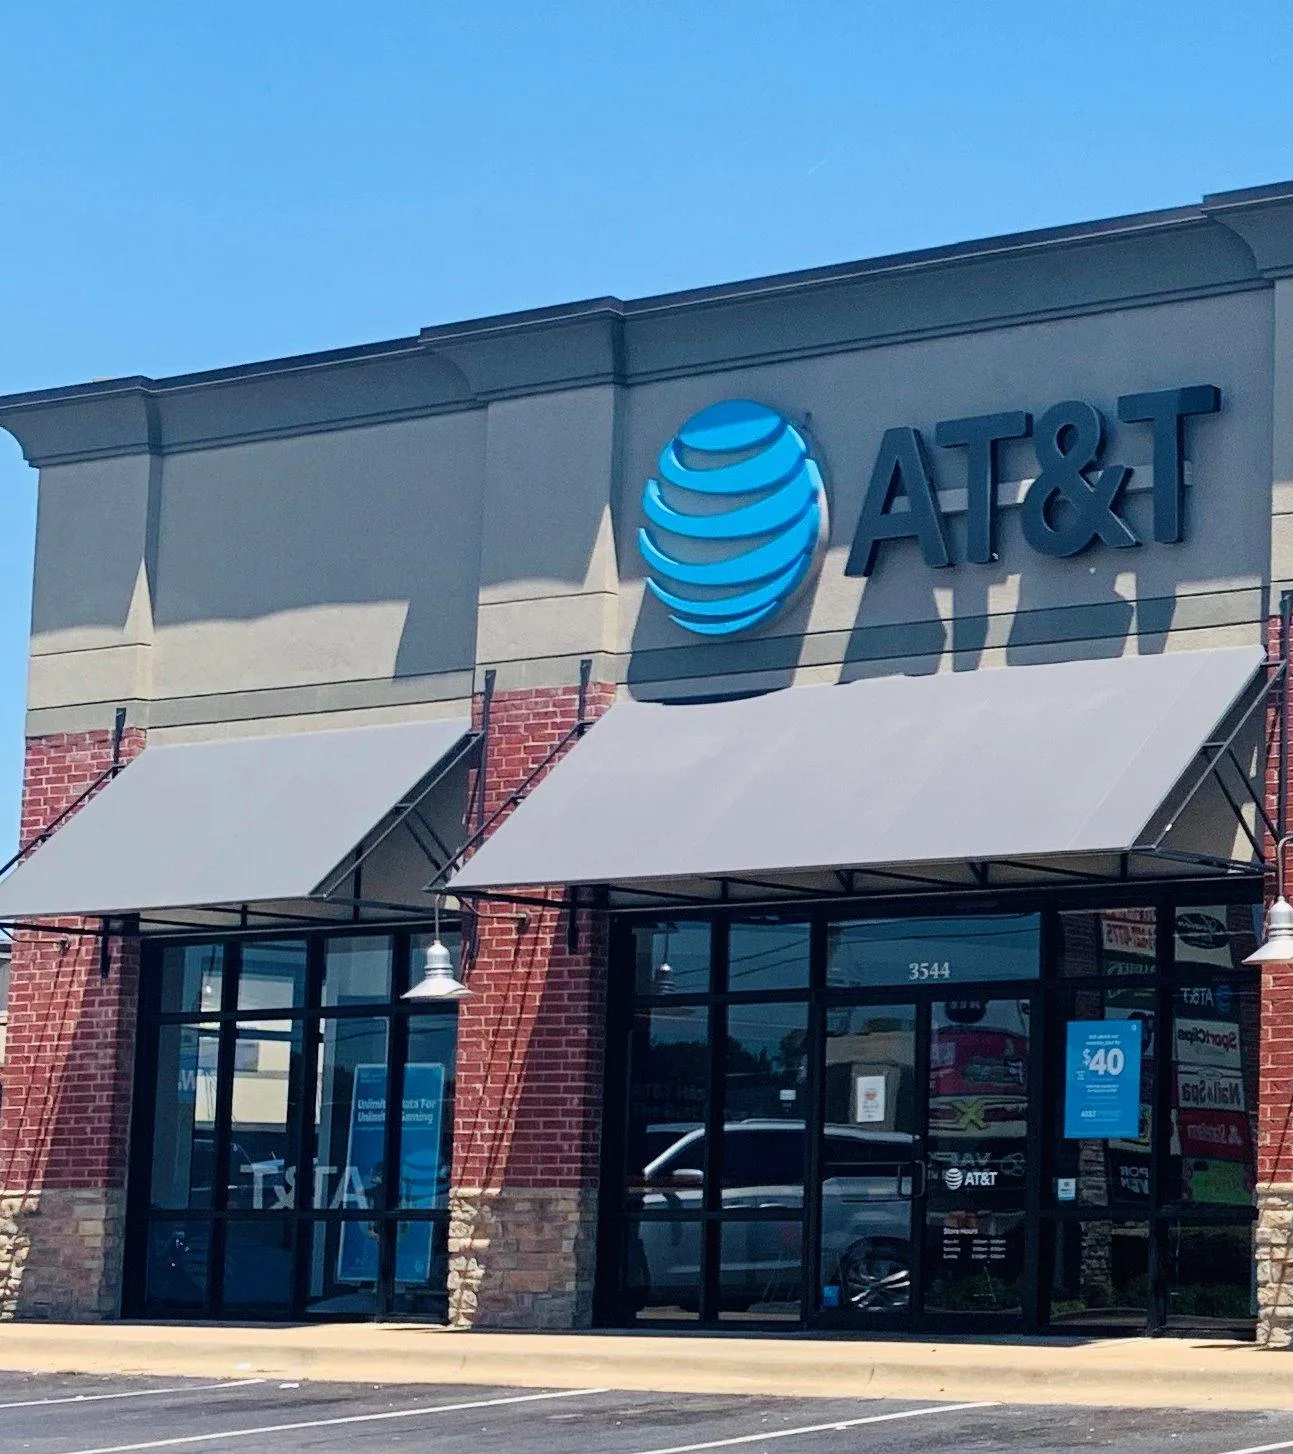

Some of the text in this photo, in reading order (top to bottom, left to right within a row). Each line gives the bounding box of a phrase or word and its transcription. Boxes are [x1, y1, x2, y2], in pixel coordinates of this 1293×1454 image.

[843, 384, 1222, 577] AT&T
[908, 962, 950, 980] 3544
[1083, 1048, 1124, 1075] $40
[964, 1171, 998, 1186] AT&T
